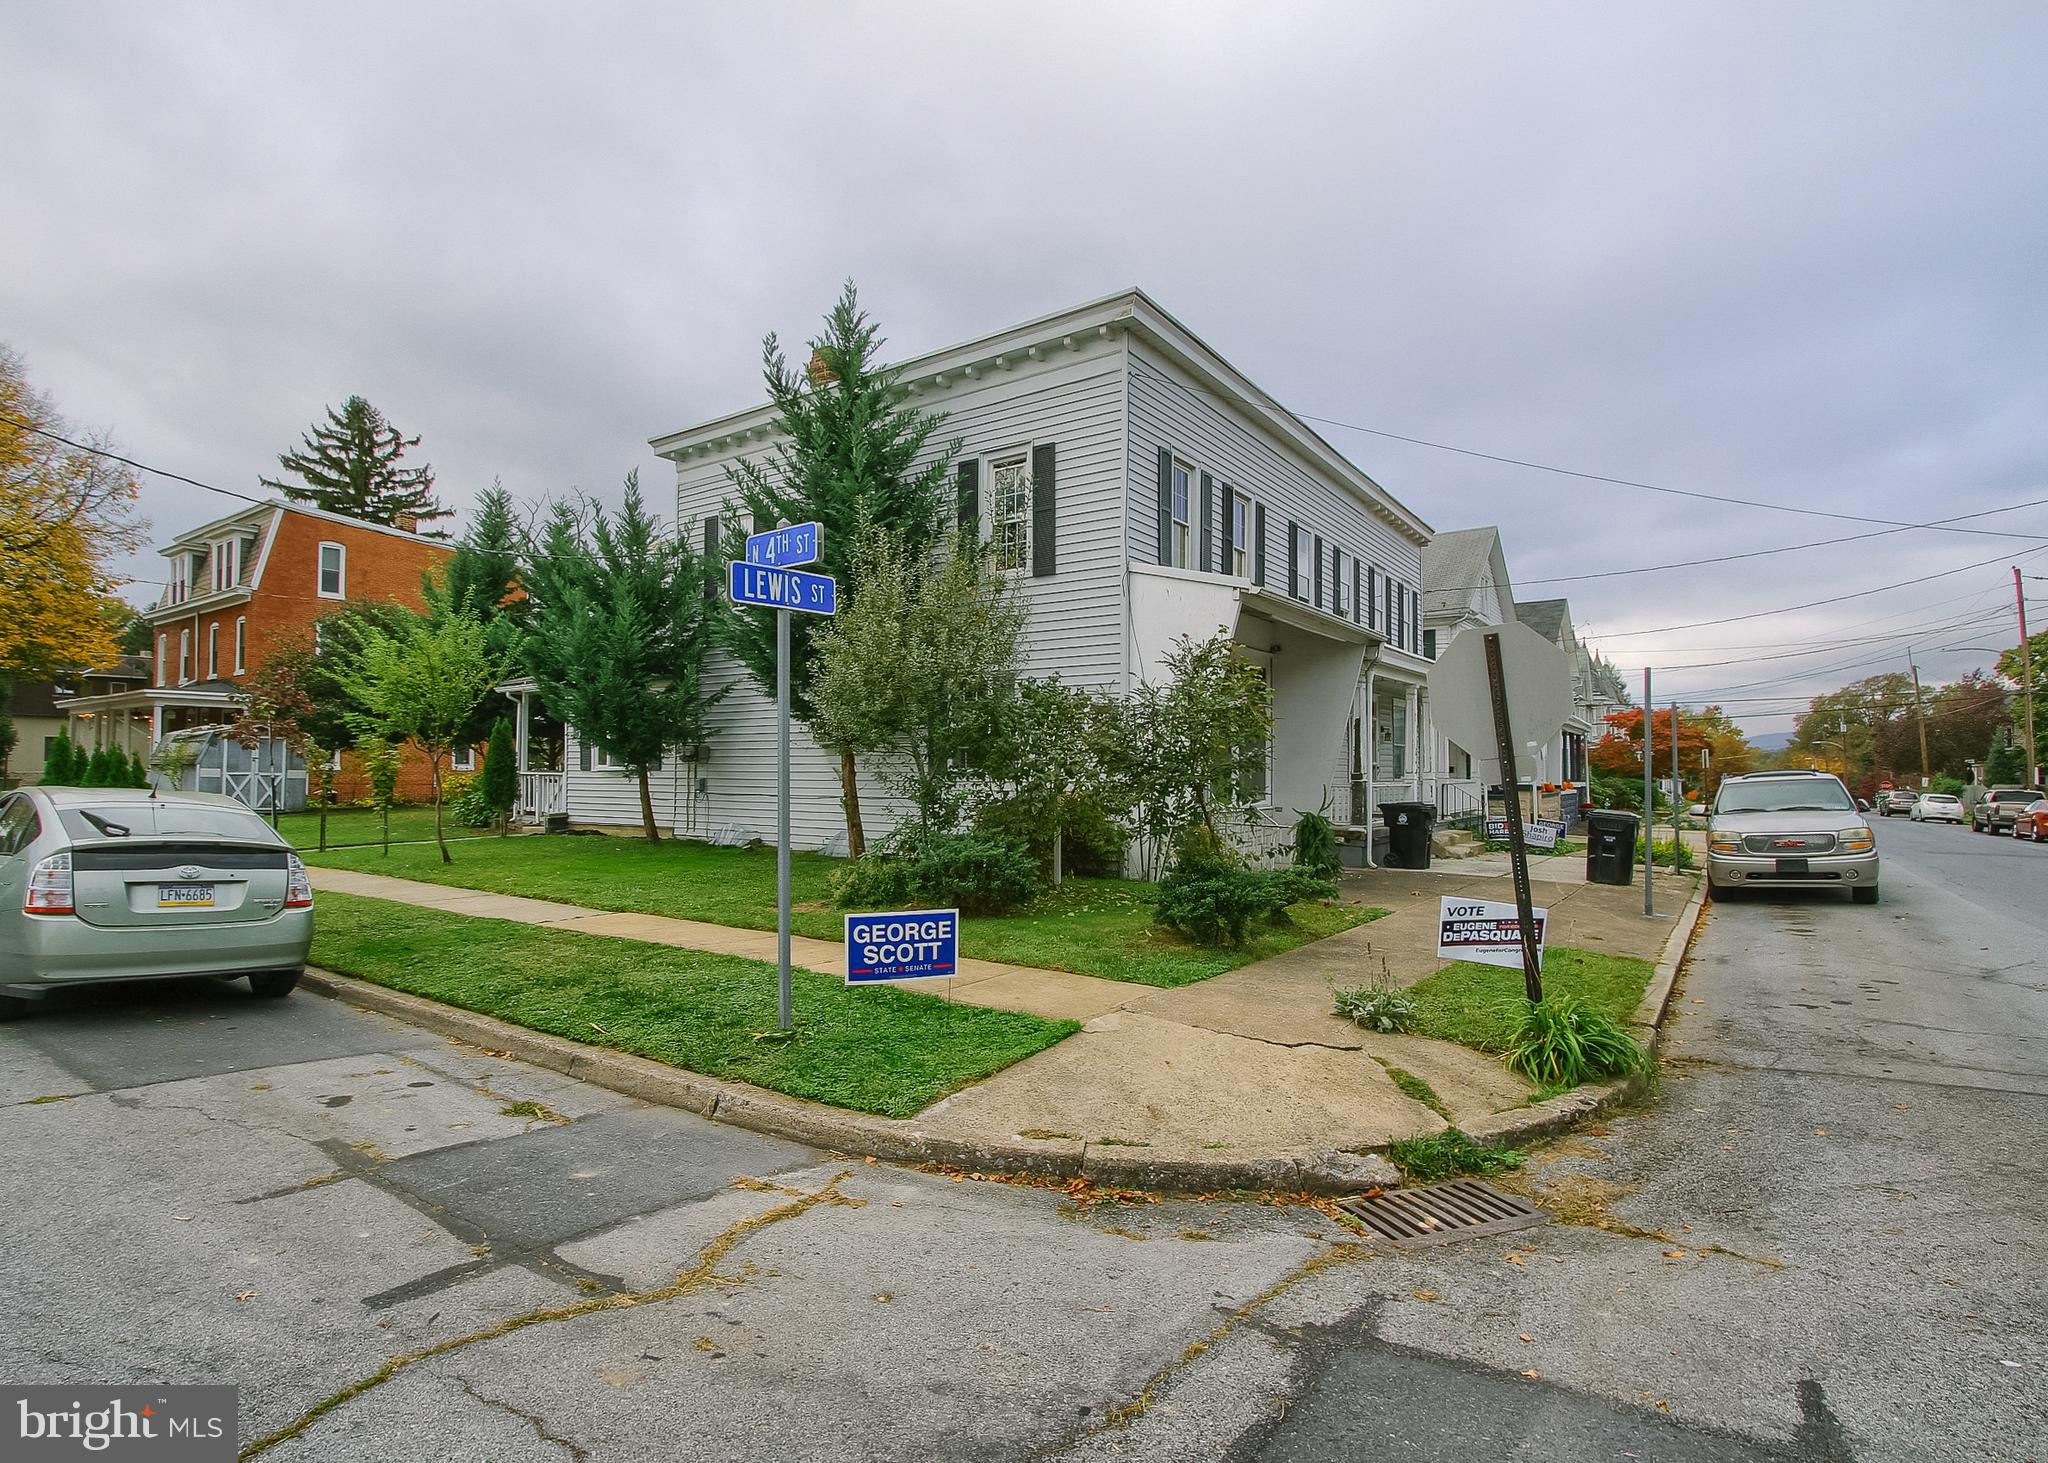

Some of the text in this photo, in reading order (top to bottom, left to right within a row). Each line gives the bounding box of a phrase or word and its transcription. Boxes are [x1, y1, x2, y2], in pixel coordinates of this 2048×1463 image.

[752, 533, 810, 564] N 4TH ST
[744, 568, 825, 604] LEWIS ST
[1530, 826, 1548, 834] Josh
[1447, 906, 1485, 917] VOTE
[853, 920, 952, 944] GEORGE
[1453, 922, 1498, 931] EUGENE
[863, 941, 942, 965] SCOTT
[905, 964, 932, 972] SENATE
